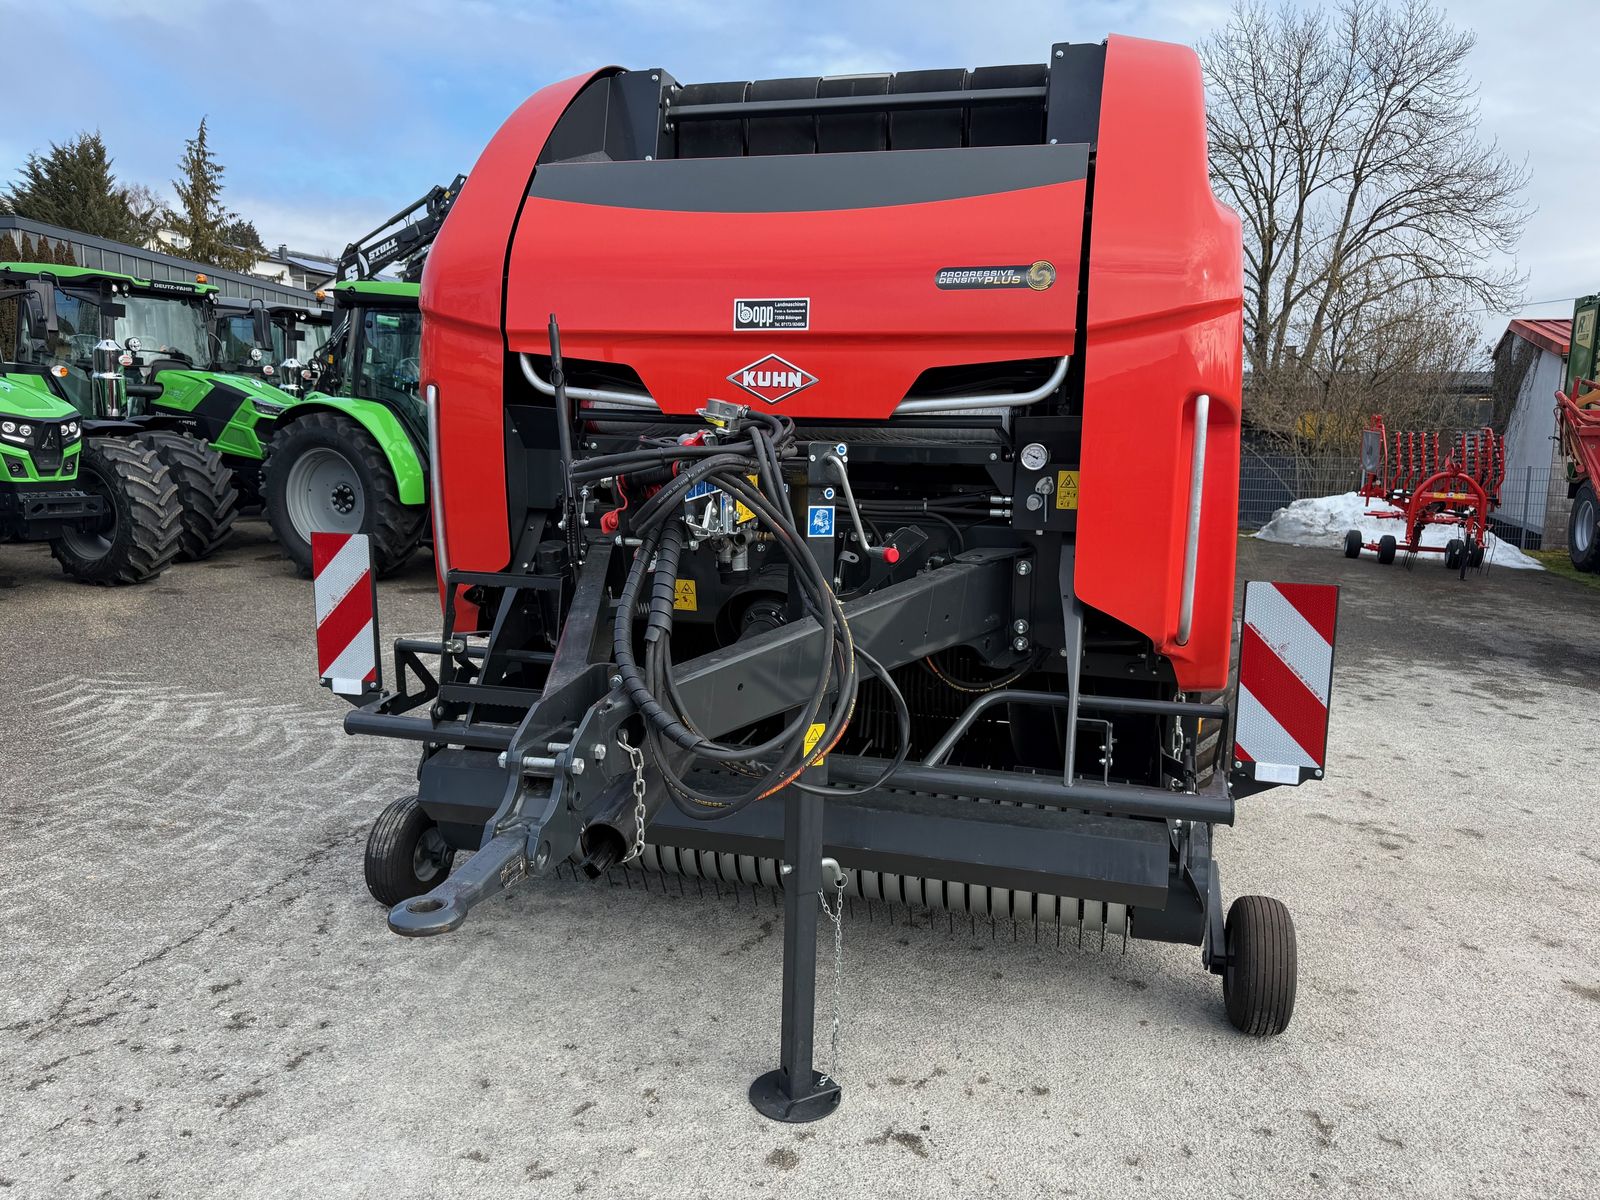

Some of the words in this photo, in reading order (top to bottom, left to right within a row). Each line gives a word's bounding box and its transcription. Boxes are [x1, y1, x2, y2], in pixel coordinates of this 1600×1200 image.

[368, 238, 398, 260] STOLL
[940, 270, 1015, 278] PROGRESSIVE
[154, 283, 193, 292] DEUTZ-FAHR
[737, 302, 774, 327] bopp
[743, 370, 802, 388] KUHN
